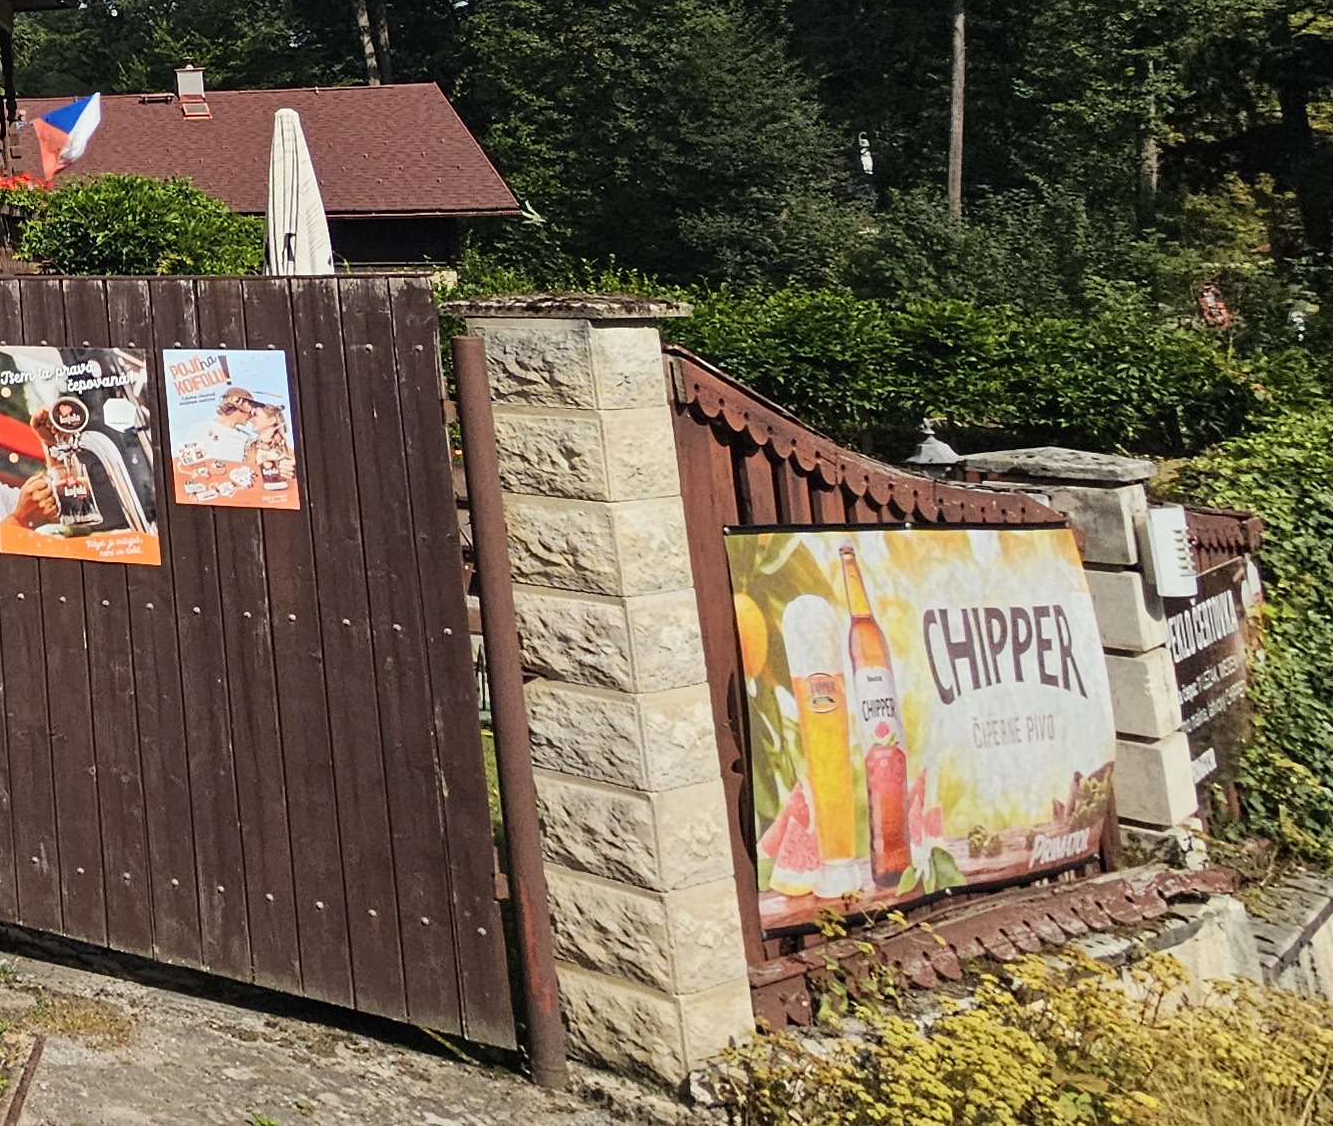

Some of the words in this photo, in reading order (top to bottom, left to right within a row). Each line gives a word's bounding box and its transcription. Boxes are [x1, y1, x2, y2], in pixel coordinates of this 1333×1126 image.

[55, 359, 96, 379] pravá
[67, 369, 134, 395] čepovaná!
[1167, 610, 1197, 664] EKLO
[923, 604, 1089, 705] CHIPPER
[862, 697, 898, 722] CHIPPER
[1025, 714, 1055, 743] PIVO
